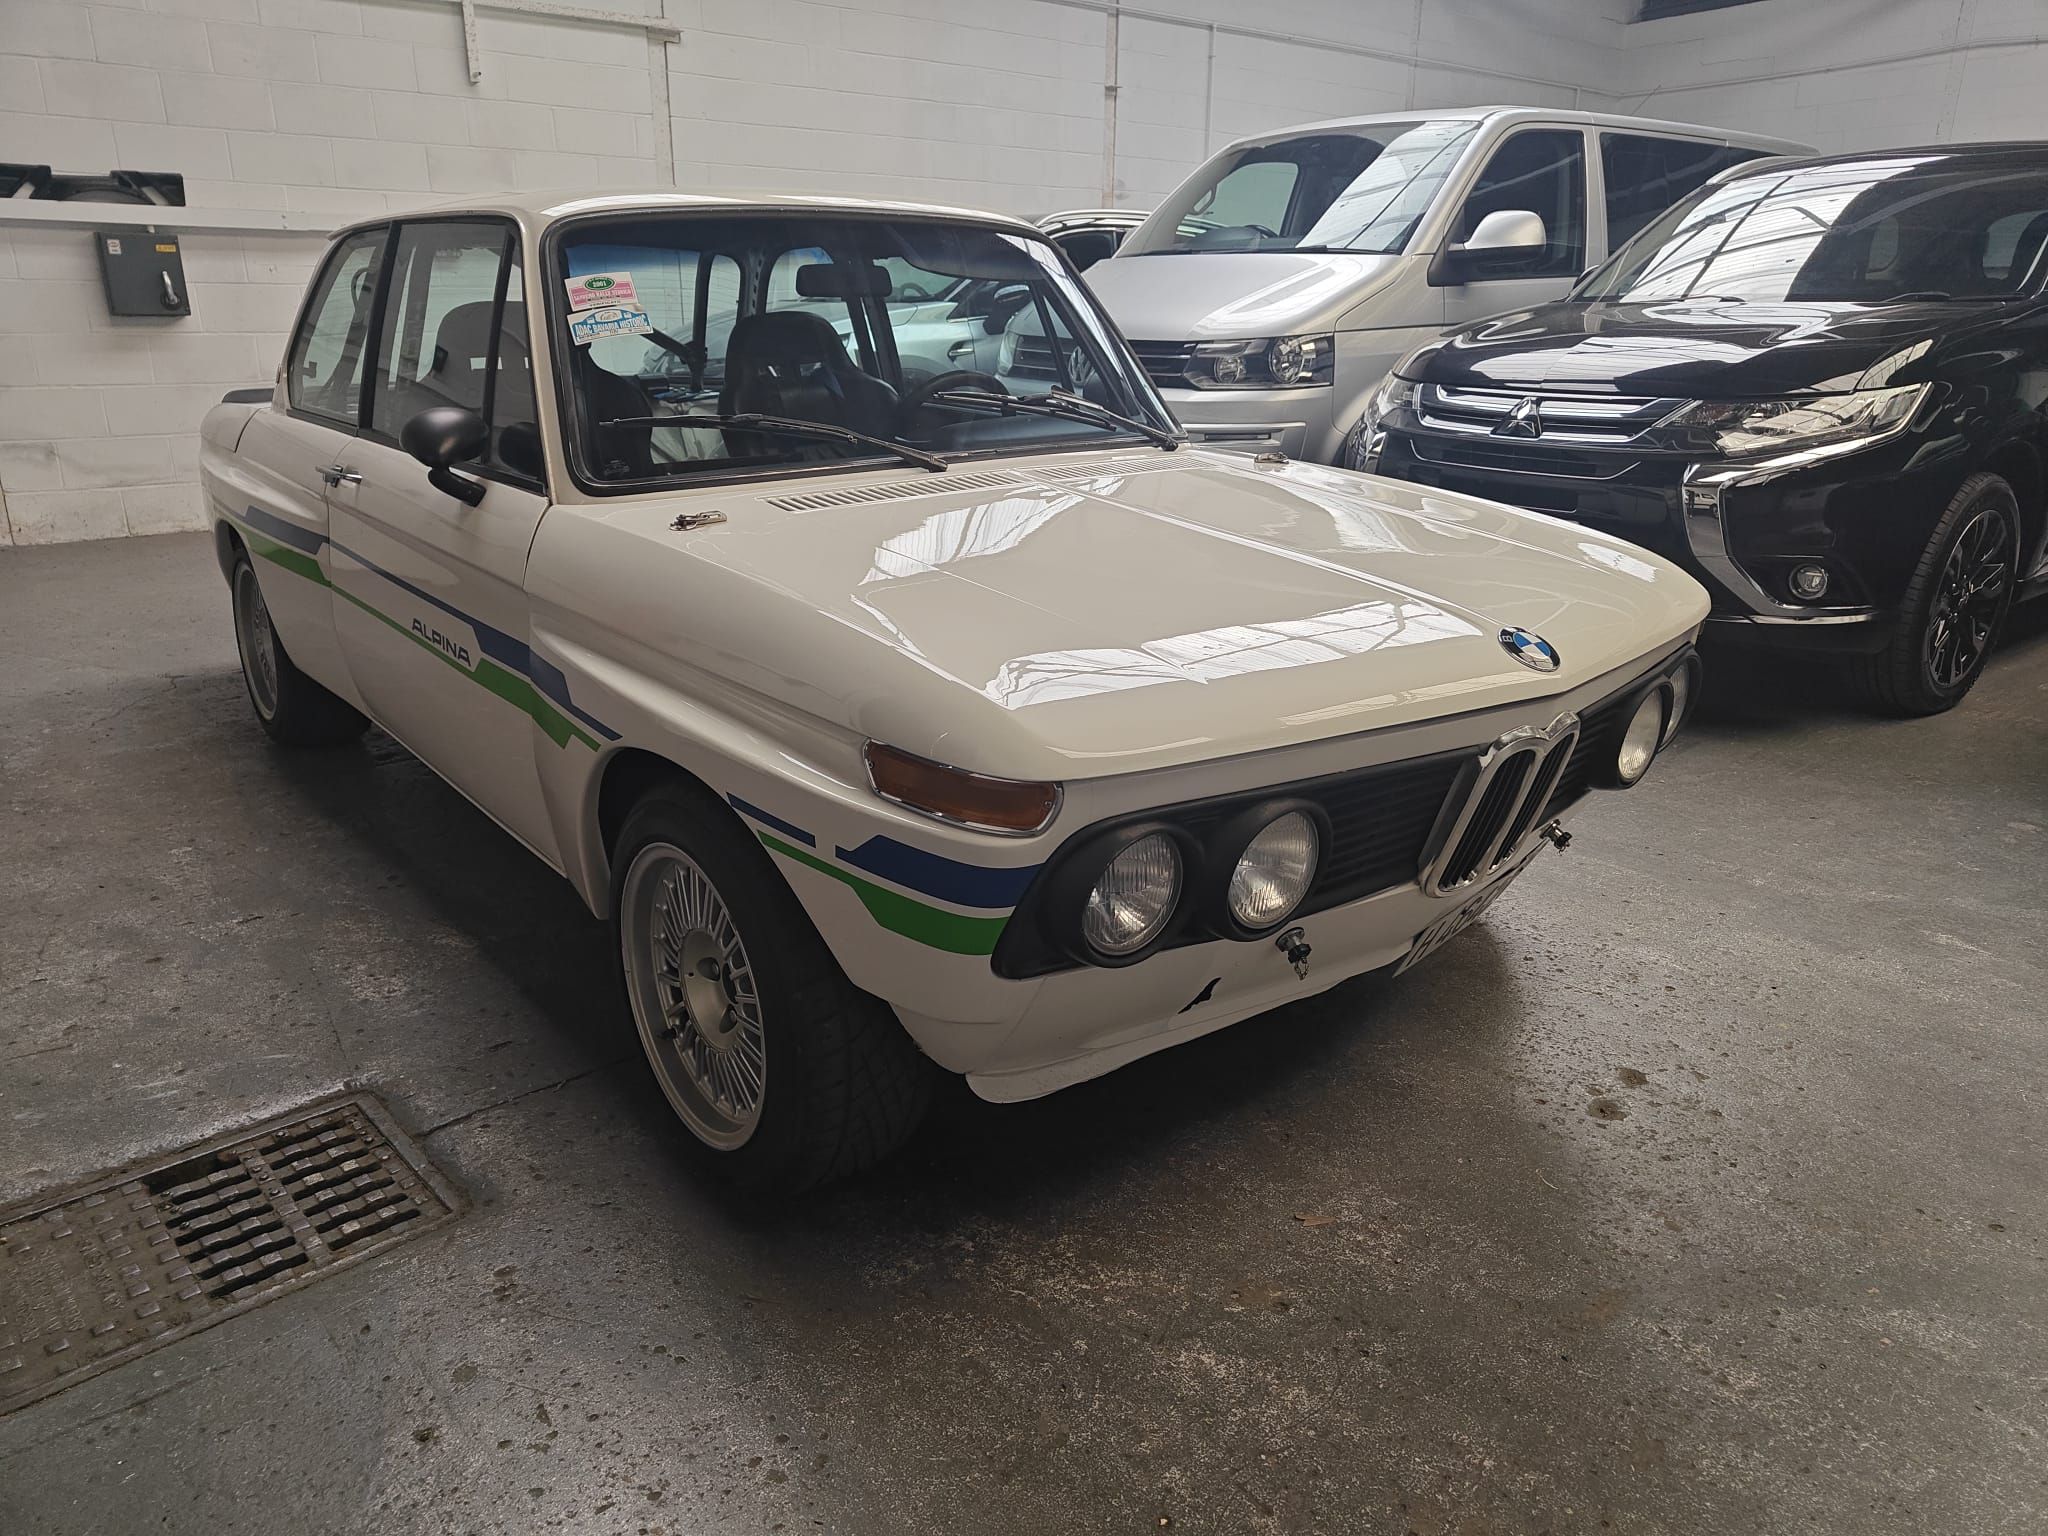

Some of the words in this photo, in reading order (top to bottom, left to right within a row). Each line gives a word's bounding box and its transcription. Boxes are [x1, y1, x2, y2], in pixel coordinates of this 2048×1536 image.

[575, 323, 593, 337] ADAC
[593, 321, 619, 332] BAVARIA
[620, 314, 648, 329] HISTORIC
[411, 618, 471, 667] ALPINA
